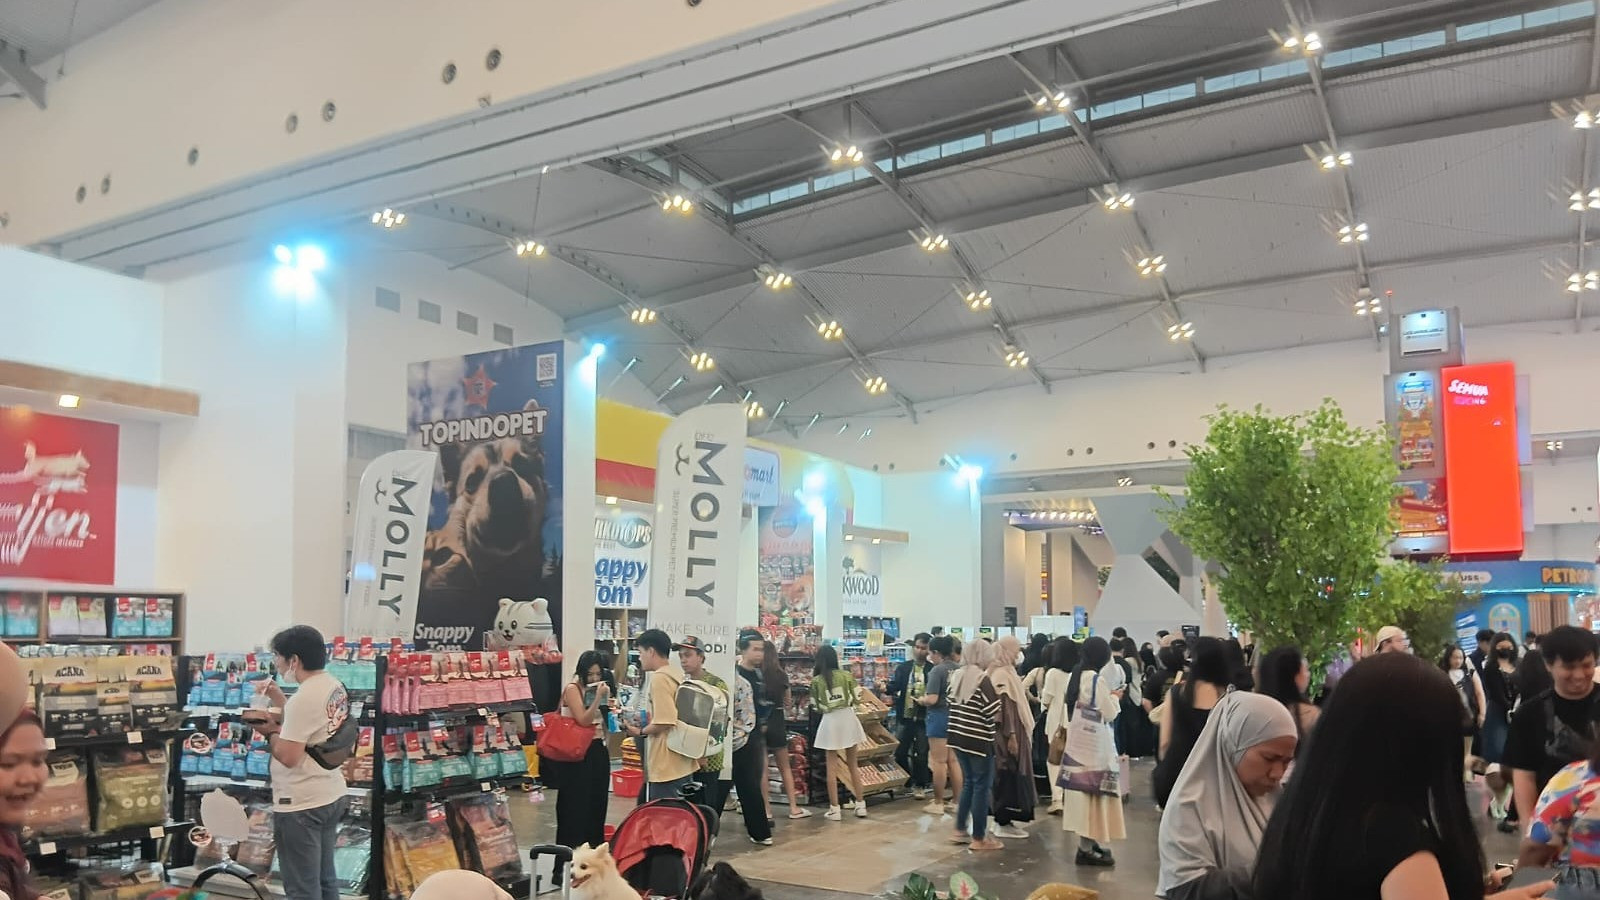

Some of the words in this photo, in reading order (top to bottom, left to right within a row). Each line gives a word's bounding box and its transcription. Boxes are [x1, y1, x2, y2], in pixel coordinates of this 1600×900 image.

[420, 410, 547, 446] TOPINDOPET
[685, 440, 728, 608] MOLLY
[378, 476, 418, 616] MOLLY
[595, 558, 648, 584] appy
[842, 575, 879, 597] KWOOD
[415, 623, 475, 643] Snappy
[655, 621, 689, 635] MAKE
[696, 624, 729, 636] SURE
[703, 643, 727, 654] OD!
[55, 666, 84, 677] ACANA
[136, 665, 161, 675] ACANA
